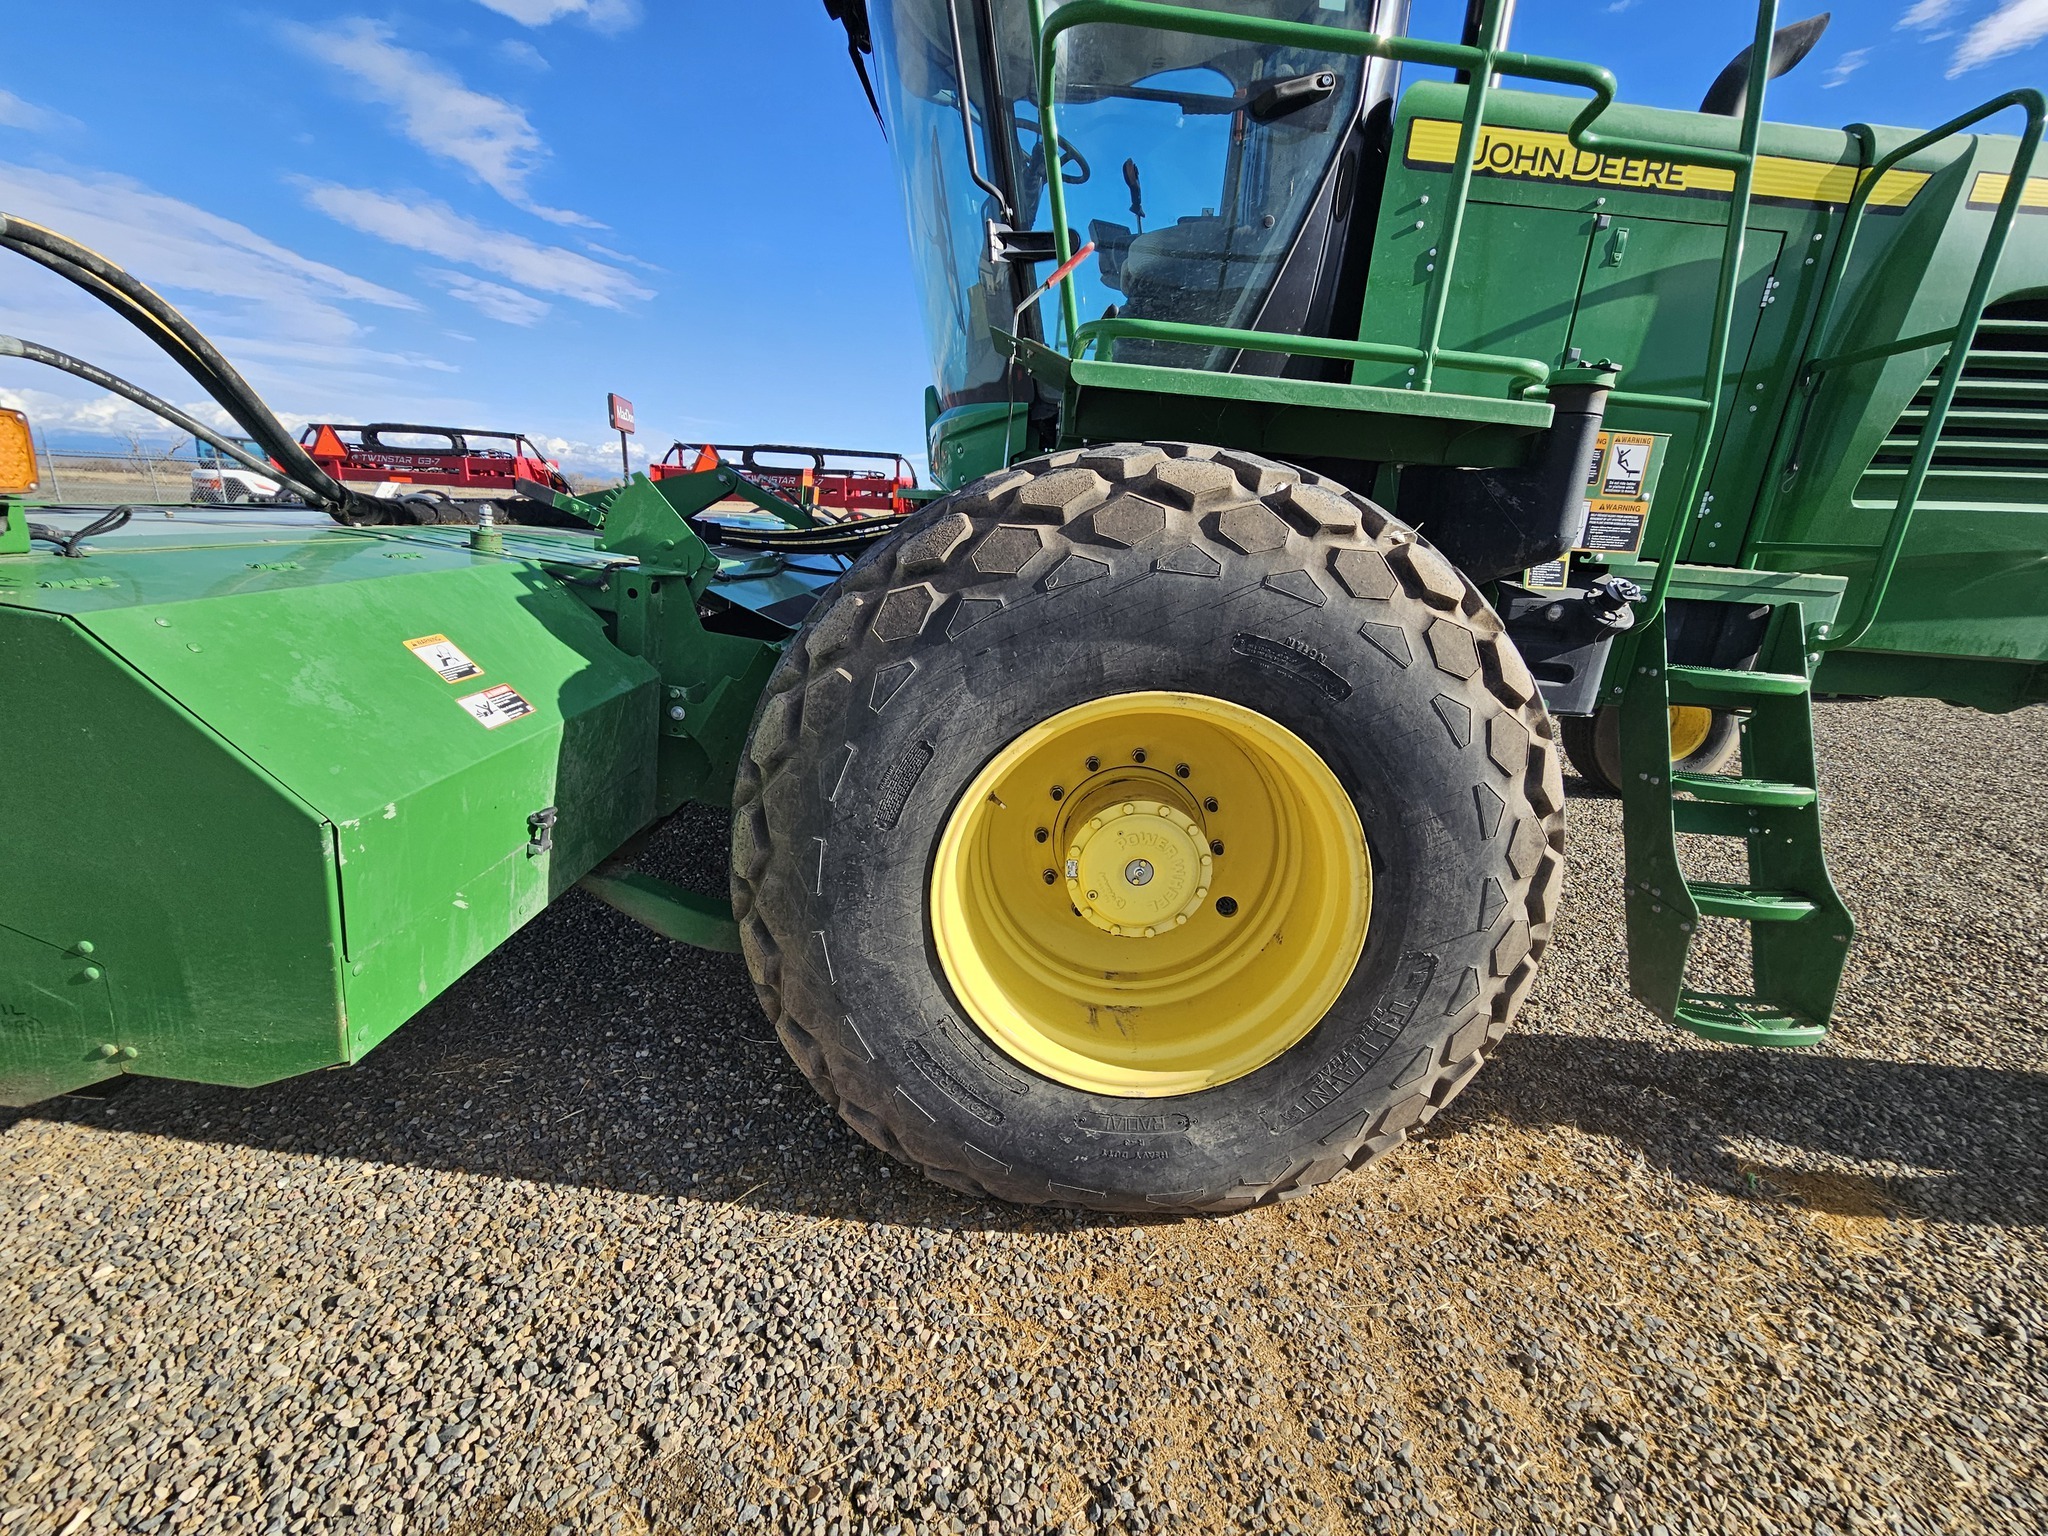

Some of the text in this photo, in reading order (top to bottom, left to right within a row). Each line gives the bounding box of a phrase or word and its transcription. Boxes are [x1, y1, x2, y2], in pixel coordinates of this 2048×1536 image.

[1473, 135, 1687, 188] JOHN DEERE
[616, 404, 634, 423] MacDon
[1621, 436, 1652, 445] WARNING
[361, 454, 413, 464] TWINSTAR
[1606, 503, 1641, 512] WARNING
[1284, 636, 1328, 663] NYLON
[1114, 831, 1186, 912] POWER WHEEL
[1302, 1000, 1418, 1110] TITAN
[1098, 1115, 1166, 1131] RADIAL
[1099, 1148, 1169, 1159] HEAVY DUTY
